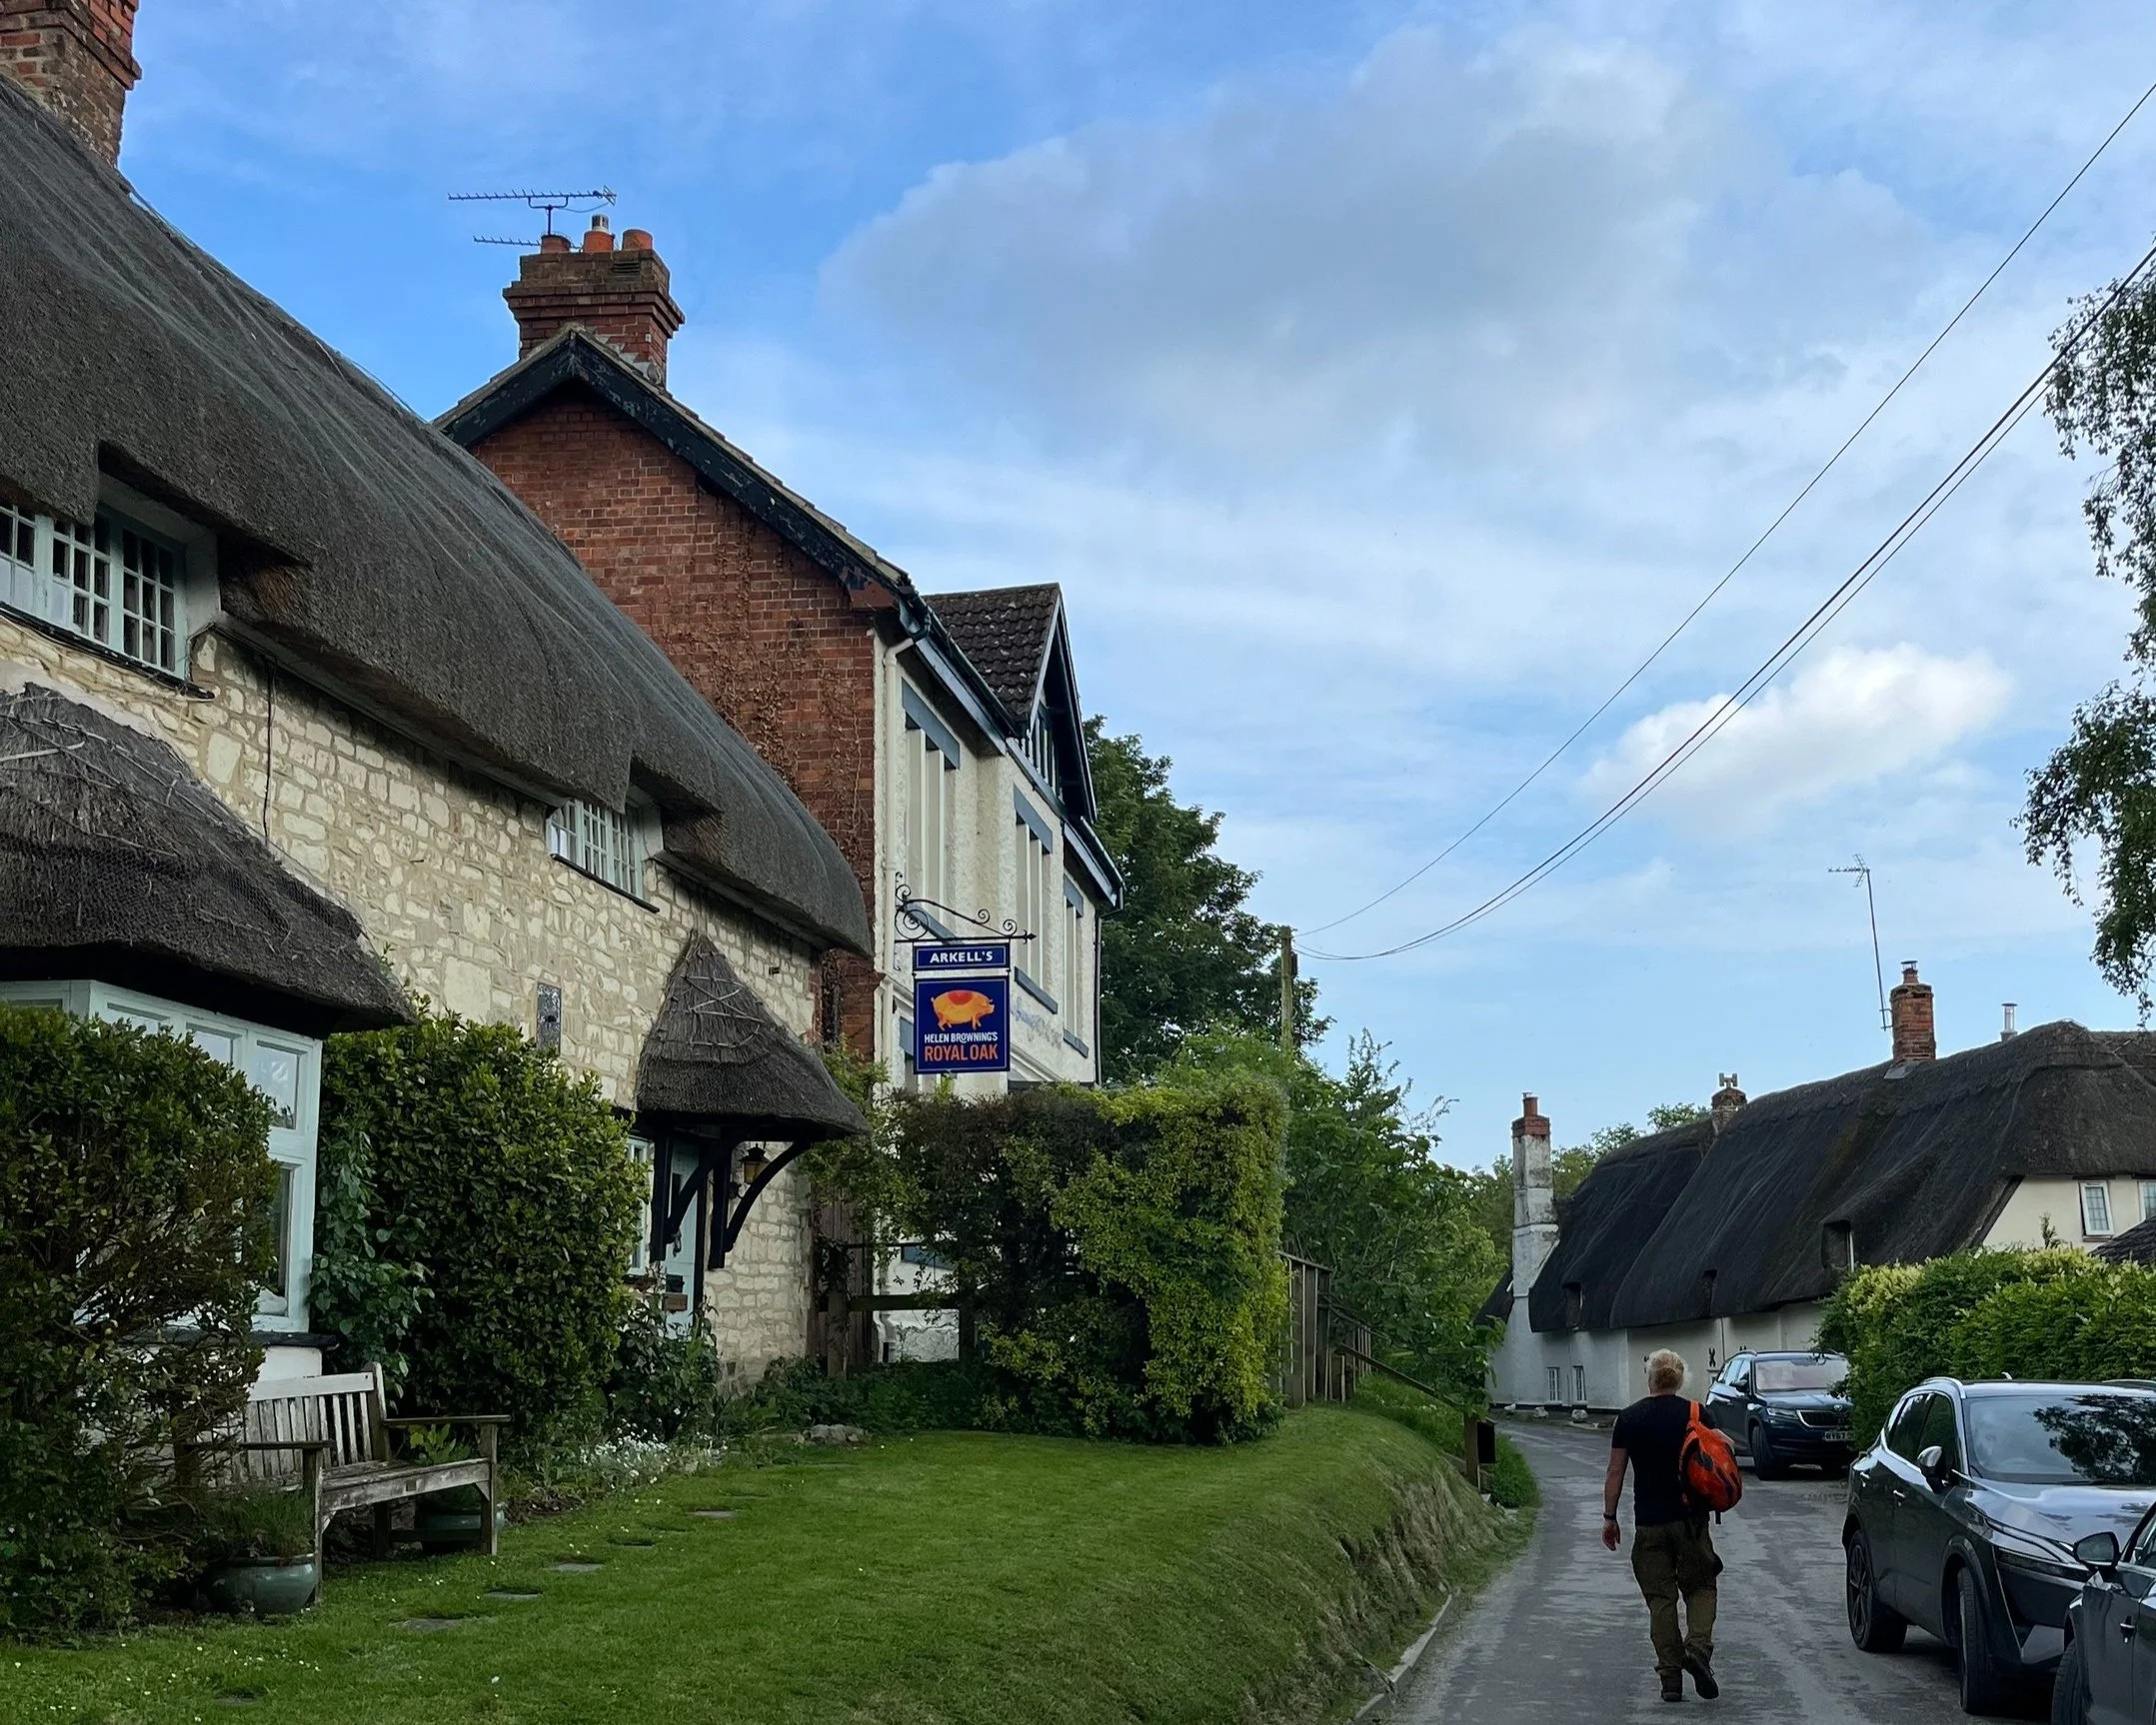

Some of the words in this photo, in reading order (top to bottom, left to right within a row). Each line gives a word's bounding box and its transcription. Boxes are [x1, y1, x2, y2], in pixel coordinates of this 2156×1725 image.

[930, 951, 994, 963] ARKELL'S
[924, 1033, 950, 1043] HELEN
[925, 1045, 968, 1061] ROYAL
[970, 1043, 999, 1060] OAK
